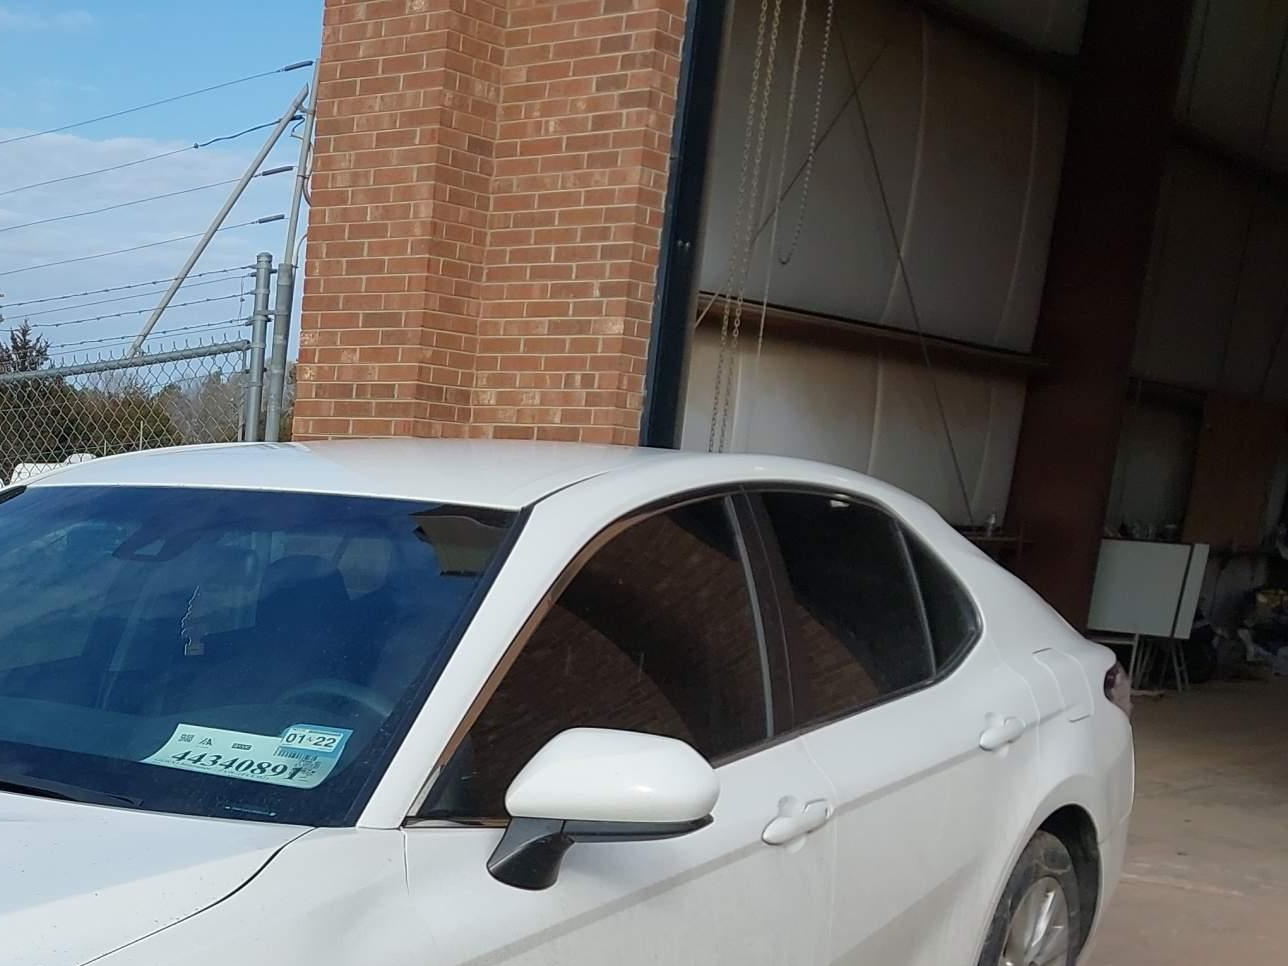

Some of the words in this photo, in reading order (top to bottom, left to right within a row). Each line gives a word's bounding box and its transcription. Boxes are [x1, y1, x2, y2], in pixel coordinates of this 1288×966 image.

[285, 733, 307, 744] 01
[312, 736, 337, 748] 22
[171, 750, 303, 780] 44340891
